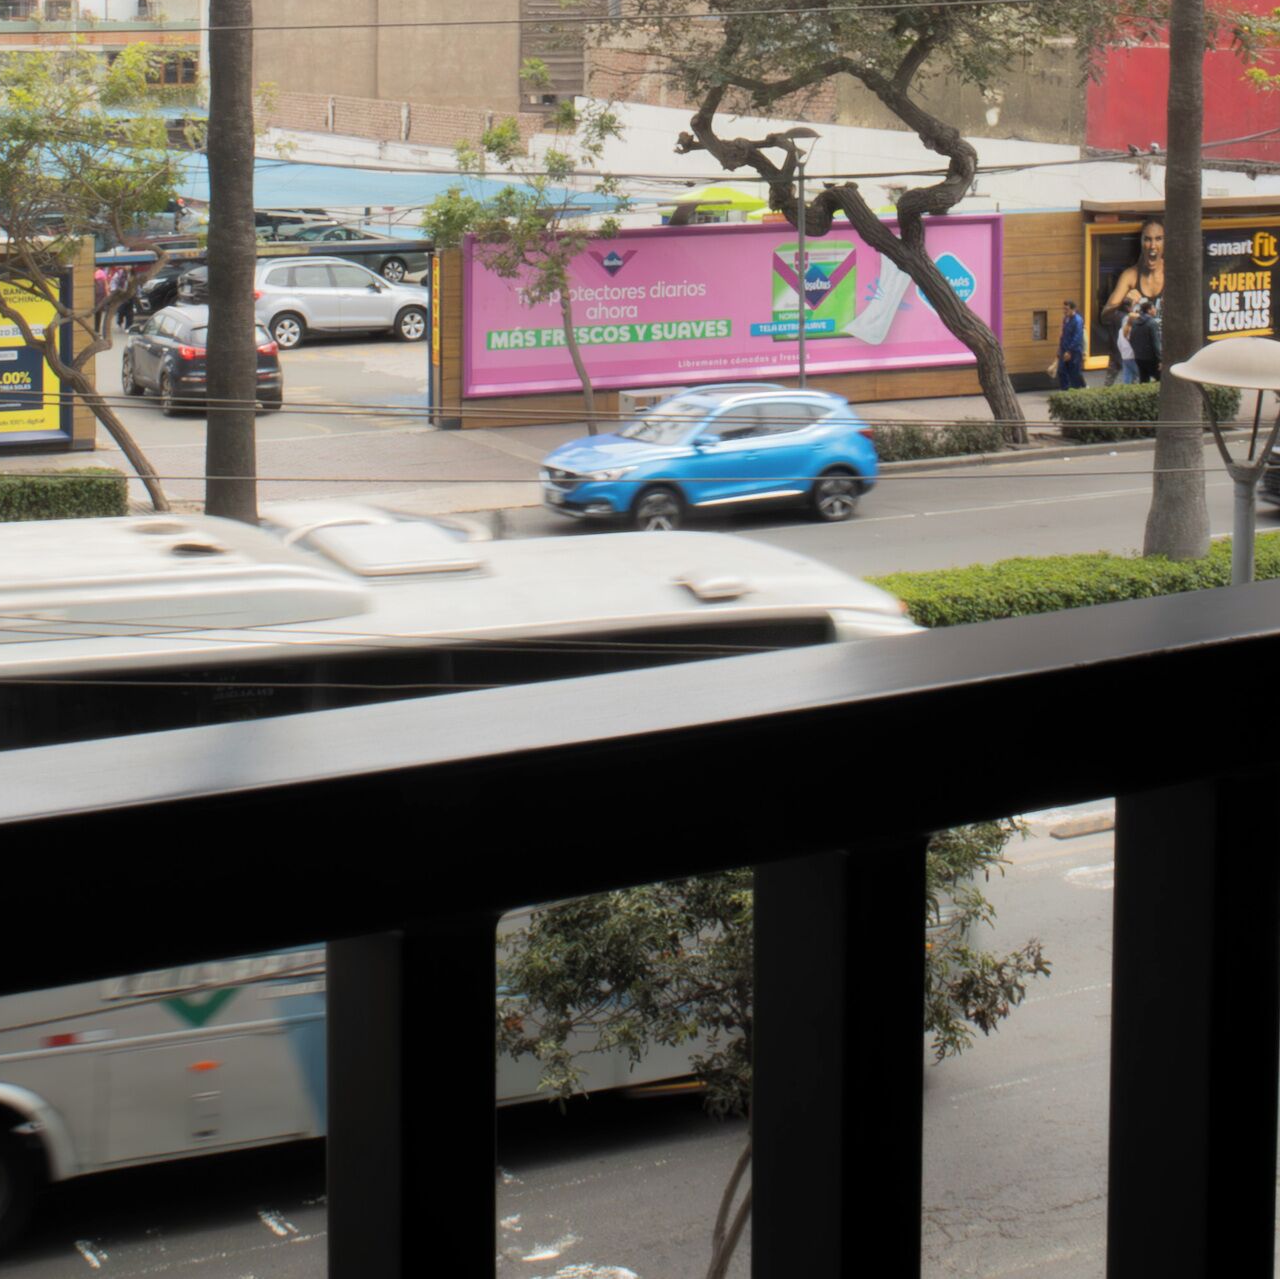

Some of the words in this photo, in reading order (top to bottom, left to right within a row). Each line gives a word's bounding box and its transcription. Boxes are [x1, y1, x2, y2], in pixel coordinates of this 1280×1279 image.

[804, 277, 832, 291] osotras
[1209, 271, 1272, 291] +FUERTE
[549, 284, 646, 307] potectores
[649, 280, 707, 298] diarios
[1208, 291, 1240, 313] QUE
[1243, 290, 1271, 310] TUS
[586, 302, 638, 320] ahora
[1208, 309, 1270, 332] EXCUSAS
[490, 327, 537, 349] MÁS
[541, 324, 631, 346] FRESCOS
[635, 325, 648, 341] Y
[651, 319, 728, 340] SUAVES
[778, 322, 801, 331] EXTR
